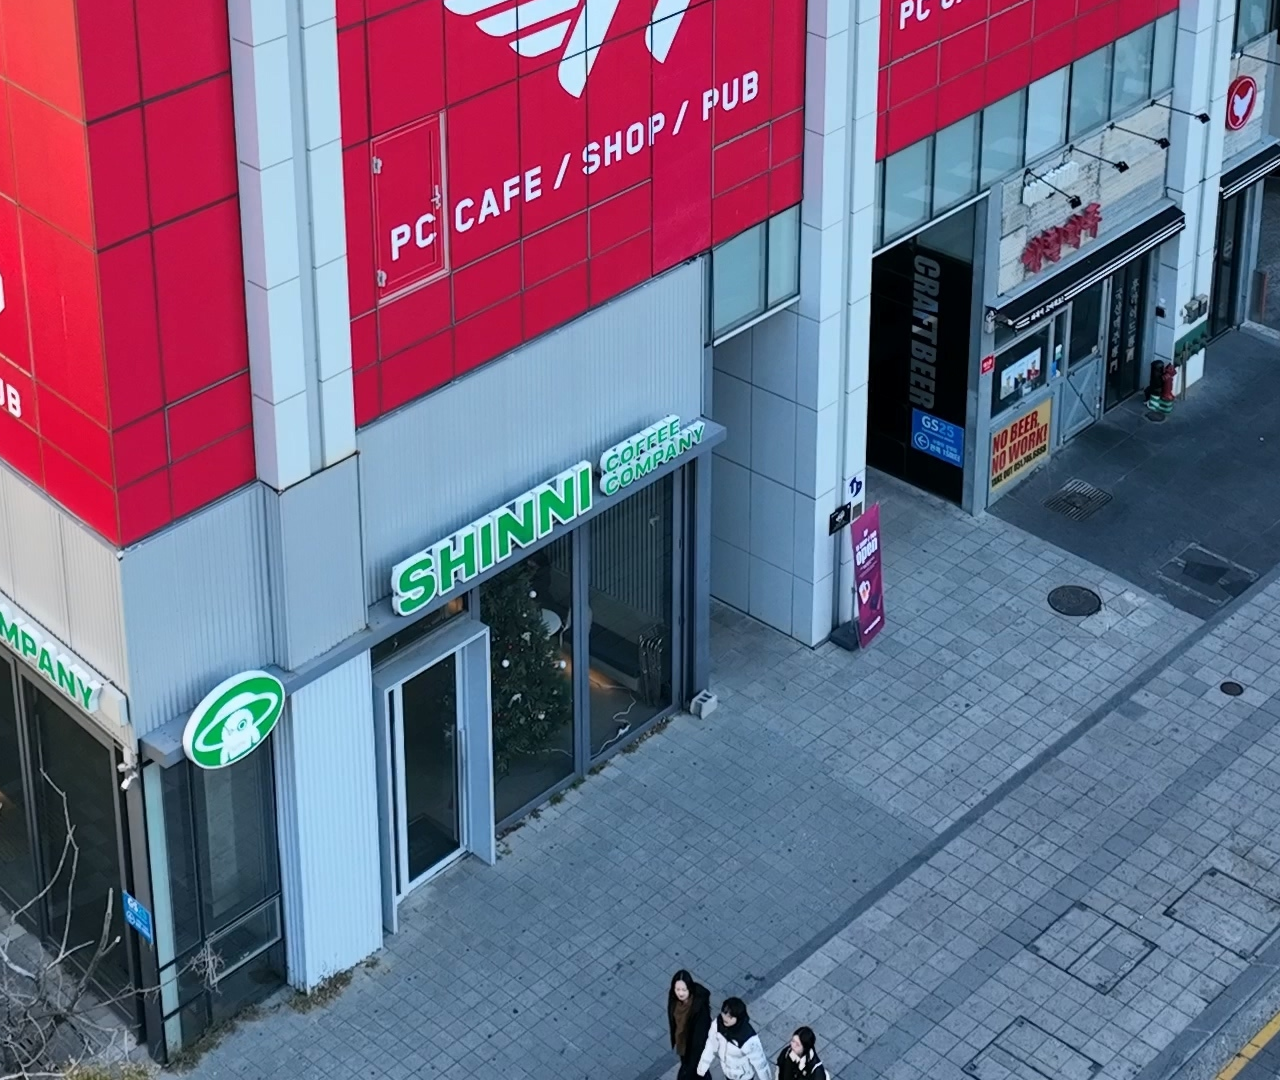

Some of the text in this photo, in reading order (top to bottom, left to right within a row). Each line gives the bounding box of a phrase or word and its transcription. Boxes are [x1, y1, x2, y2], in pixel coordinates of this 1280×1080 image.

[391, 70, 760, 262] PC CAFE / SHOP / PUB
[600, 414, 681, 475] COFFEE
[921, 414, 955, 438] GS25
[991, 422, 1049, 477] NO WORK!
[992, 430, 1008, 456] NO
[600, 420, 706, 497] COMPANY
[392, 460, 593, 617] SHINNI
[855, 536, 878, 567] open
